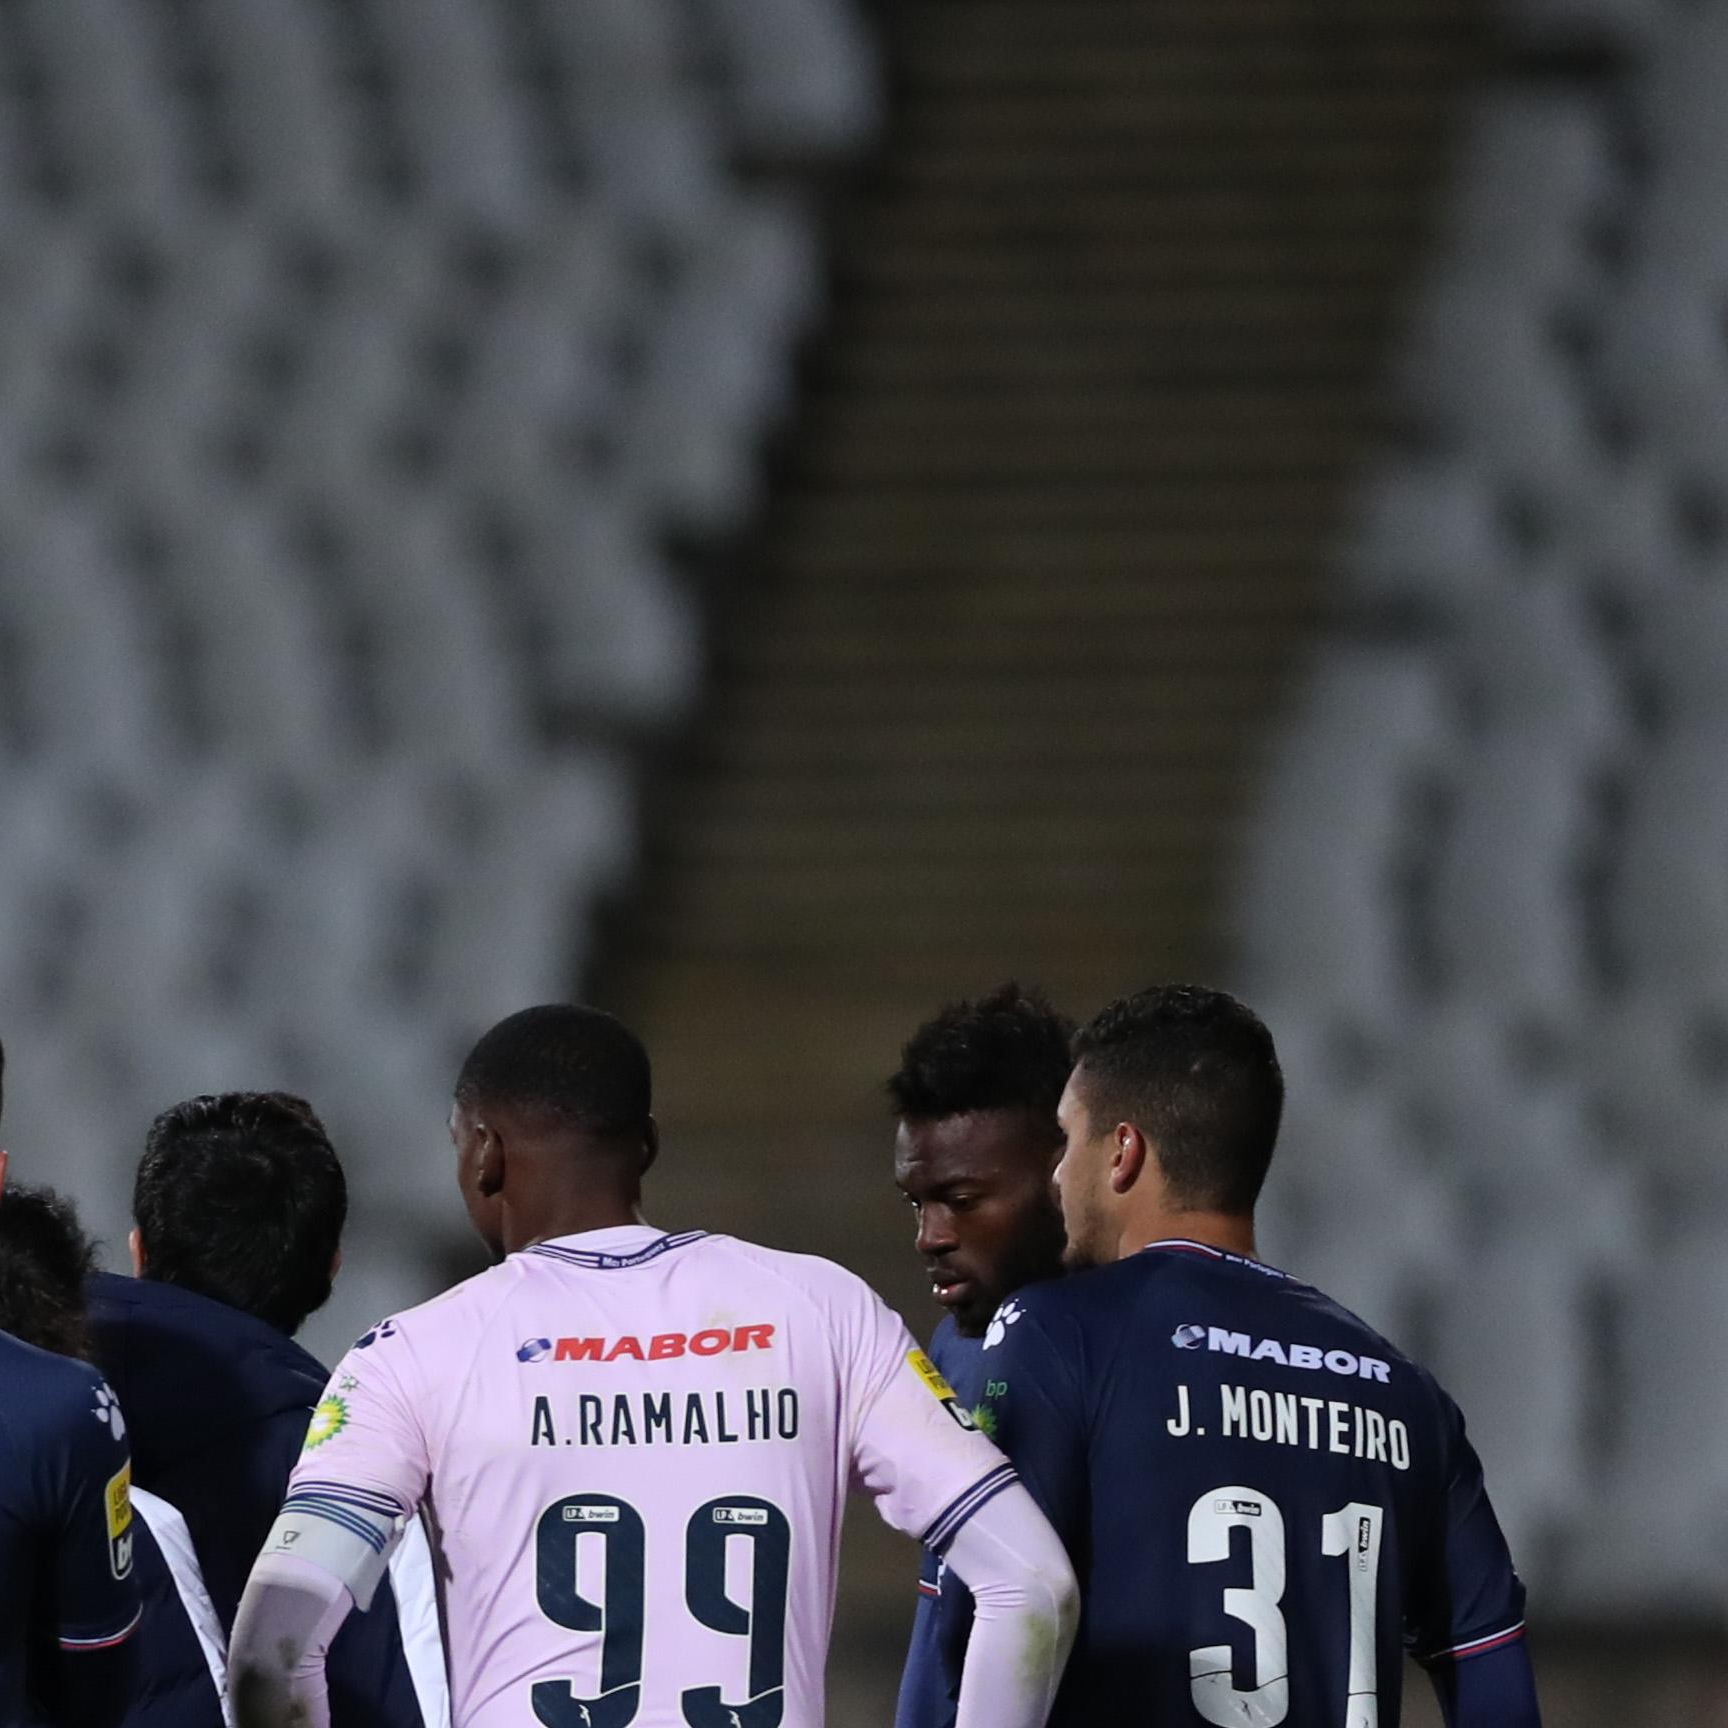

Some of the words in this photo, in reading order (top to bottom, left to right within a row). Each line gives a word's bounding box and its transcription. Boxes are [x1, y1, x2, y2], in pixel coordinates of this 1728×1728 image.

[554, 1323, 775, 1361] MABOR
[1208, 1326, 1391, 1383] MABOR
[985, 1379, 1007, 1400] bp
[531, 1388, 799, 1446] A.RAMALHO
[1167, 1385, 1205, 1437] J.
[1220, 1384, 1410, 1470] MONTEIRO
[587, 1508, 615, 1520] bwin
[737, 1509, 765, 1522] bwin
